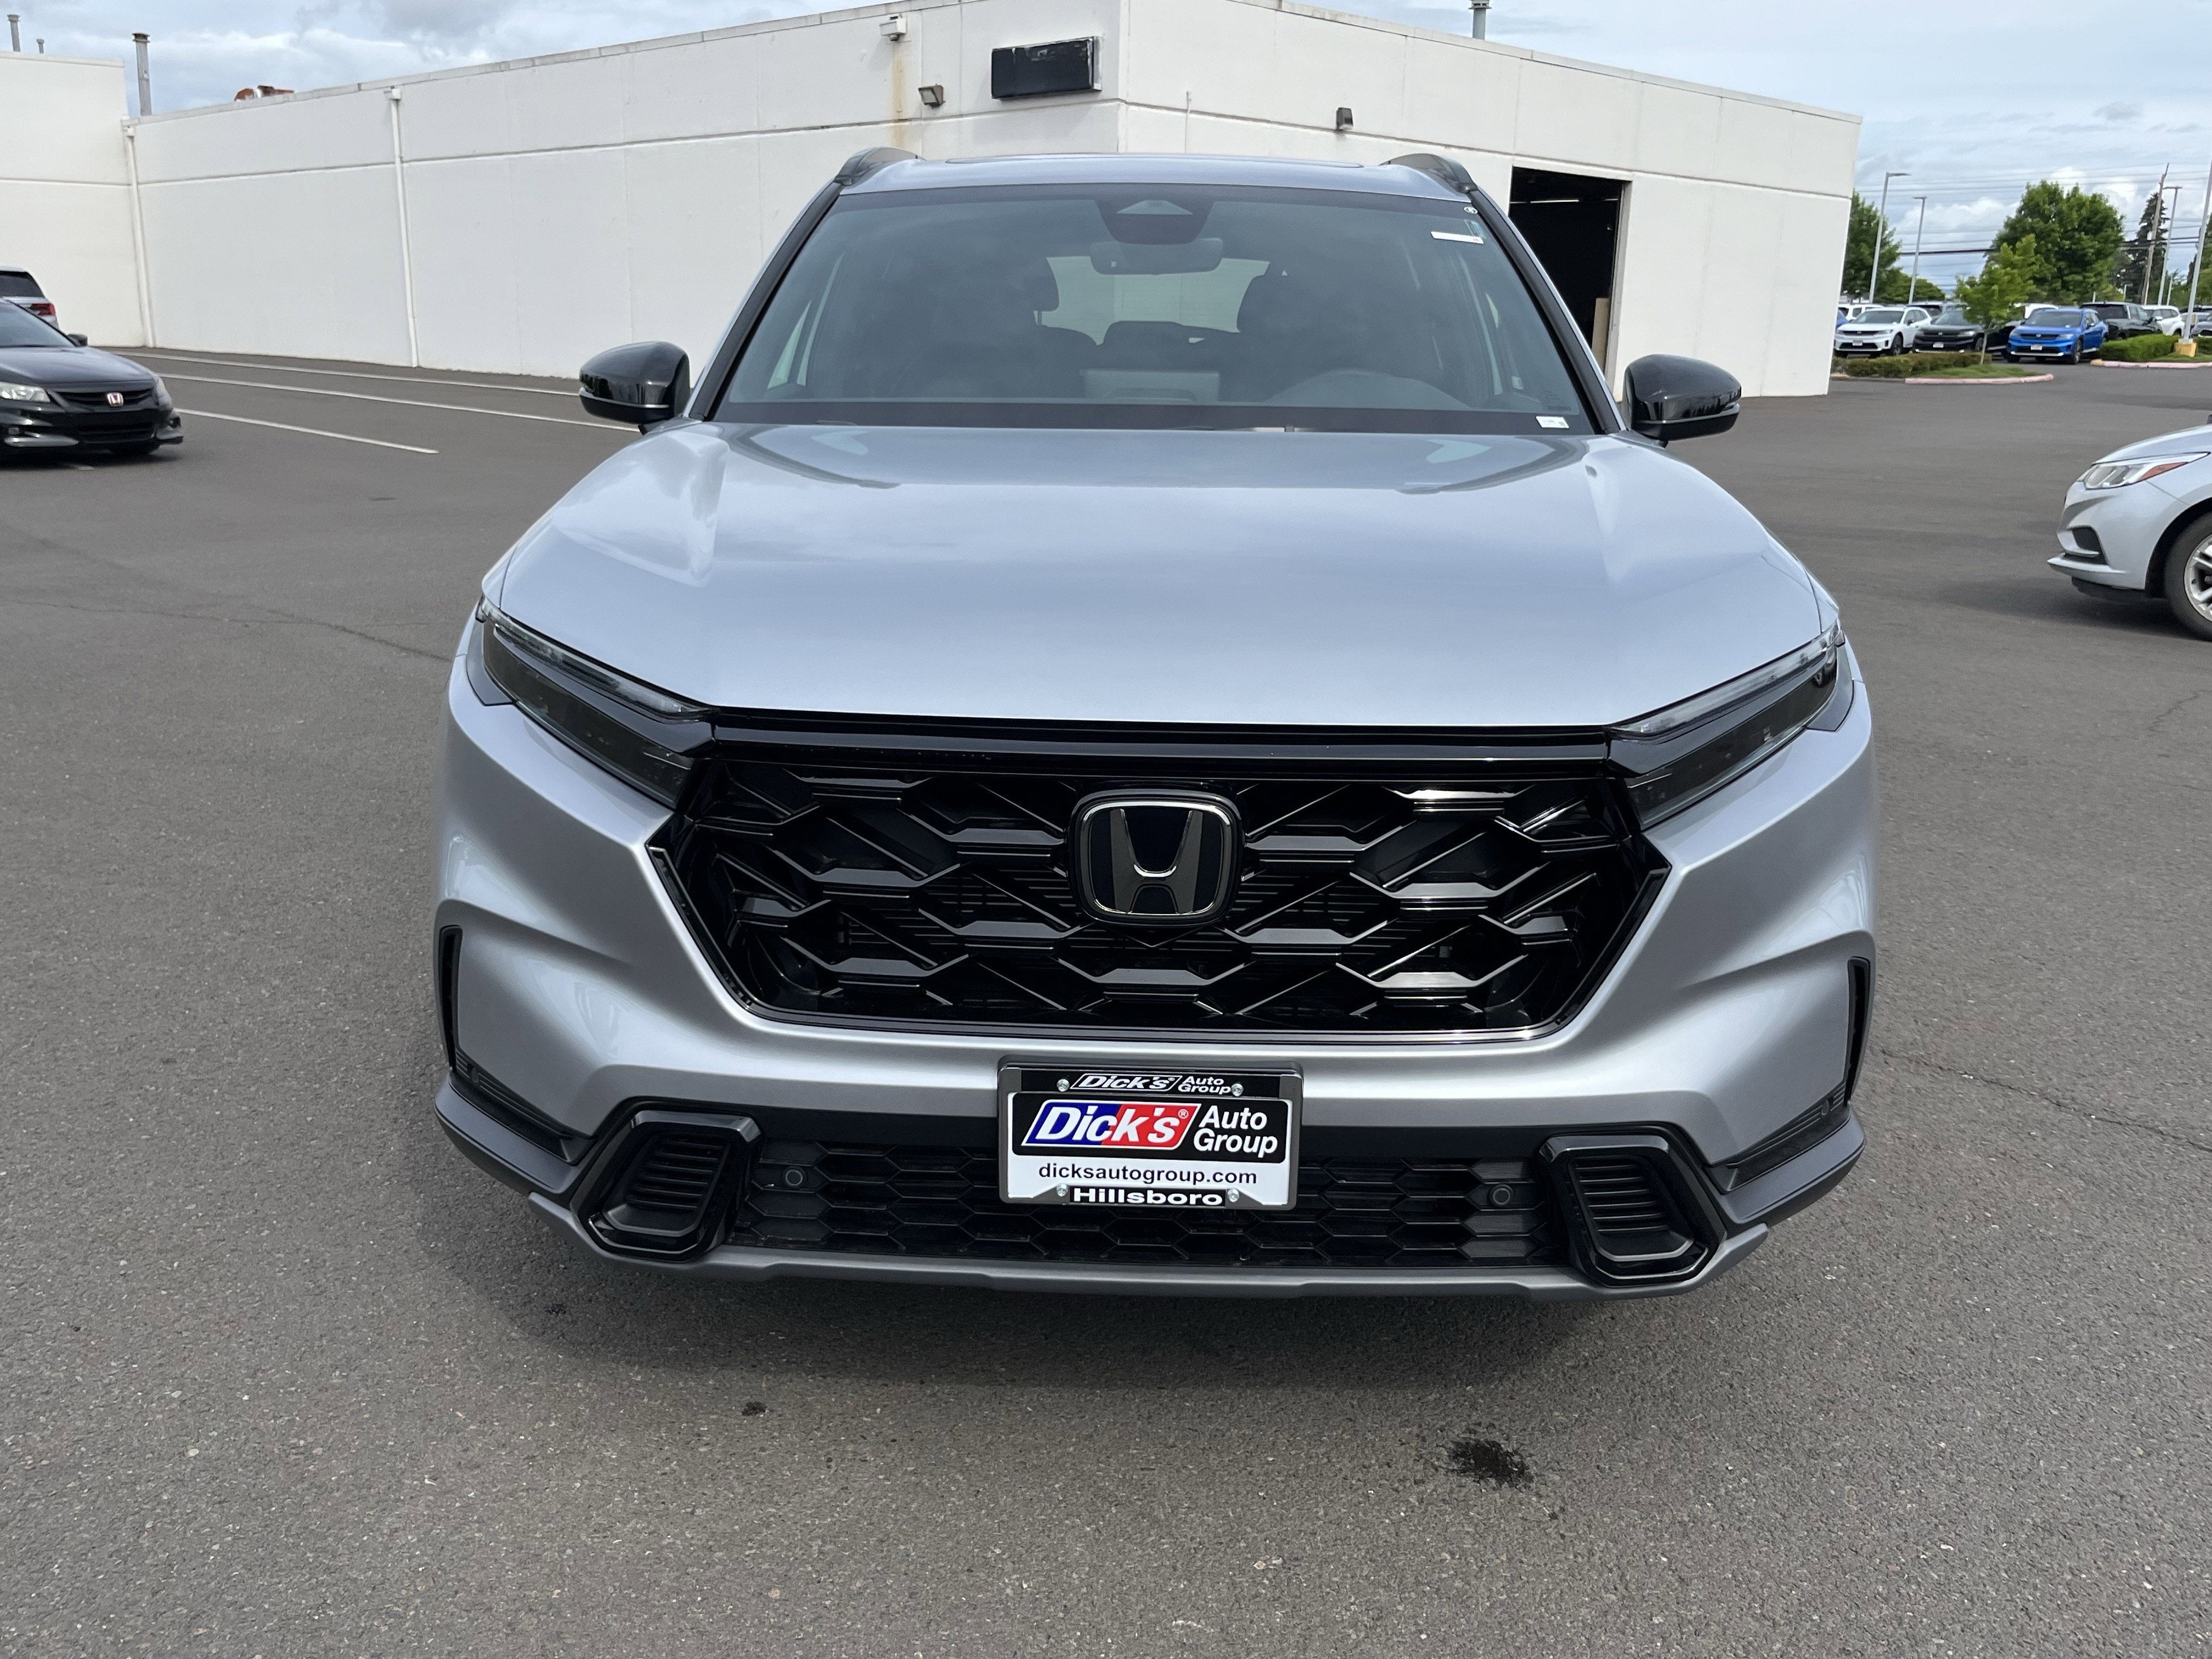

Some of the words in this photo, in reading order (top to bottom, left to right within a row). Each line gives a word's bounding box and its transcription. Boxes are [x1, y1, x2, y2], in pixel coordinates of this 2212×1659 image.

[1178, 1084, 1231, 1095] Group
[1182, 1076, 1224, 1086] Auto
[1198, 1105, 1267, 1130] Auto
[1193, 1128, 1278, 1159] Group
[1039, 1163, 1257, 1185] dicksautogroup.com
[1073, 1187, 1223, 1206] Hillsboro
